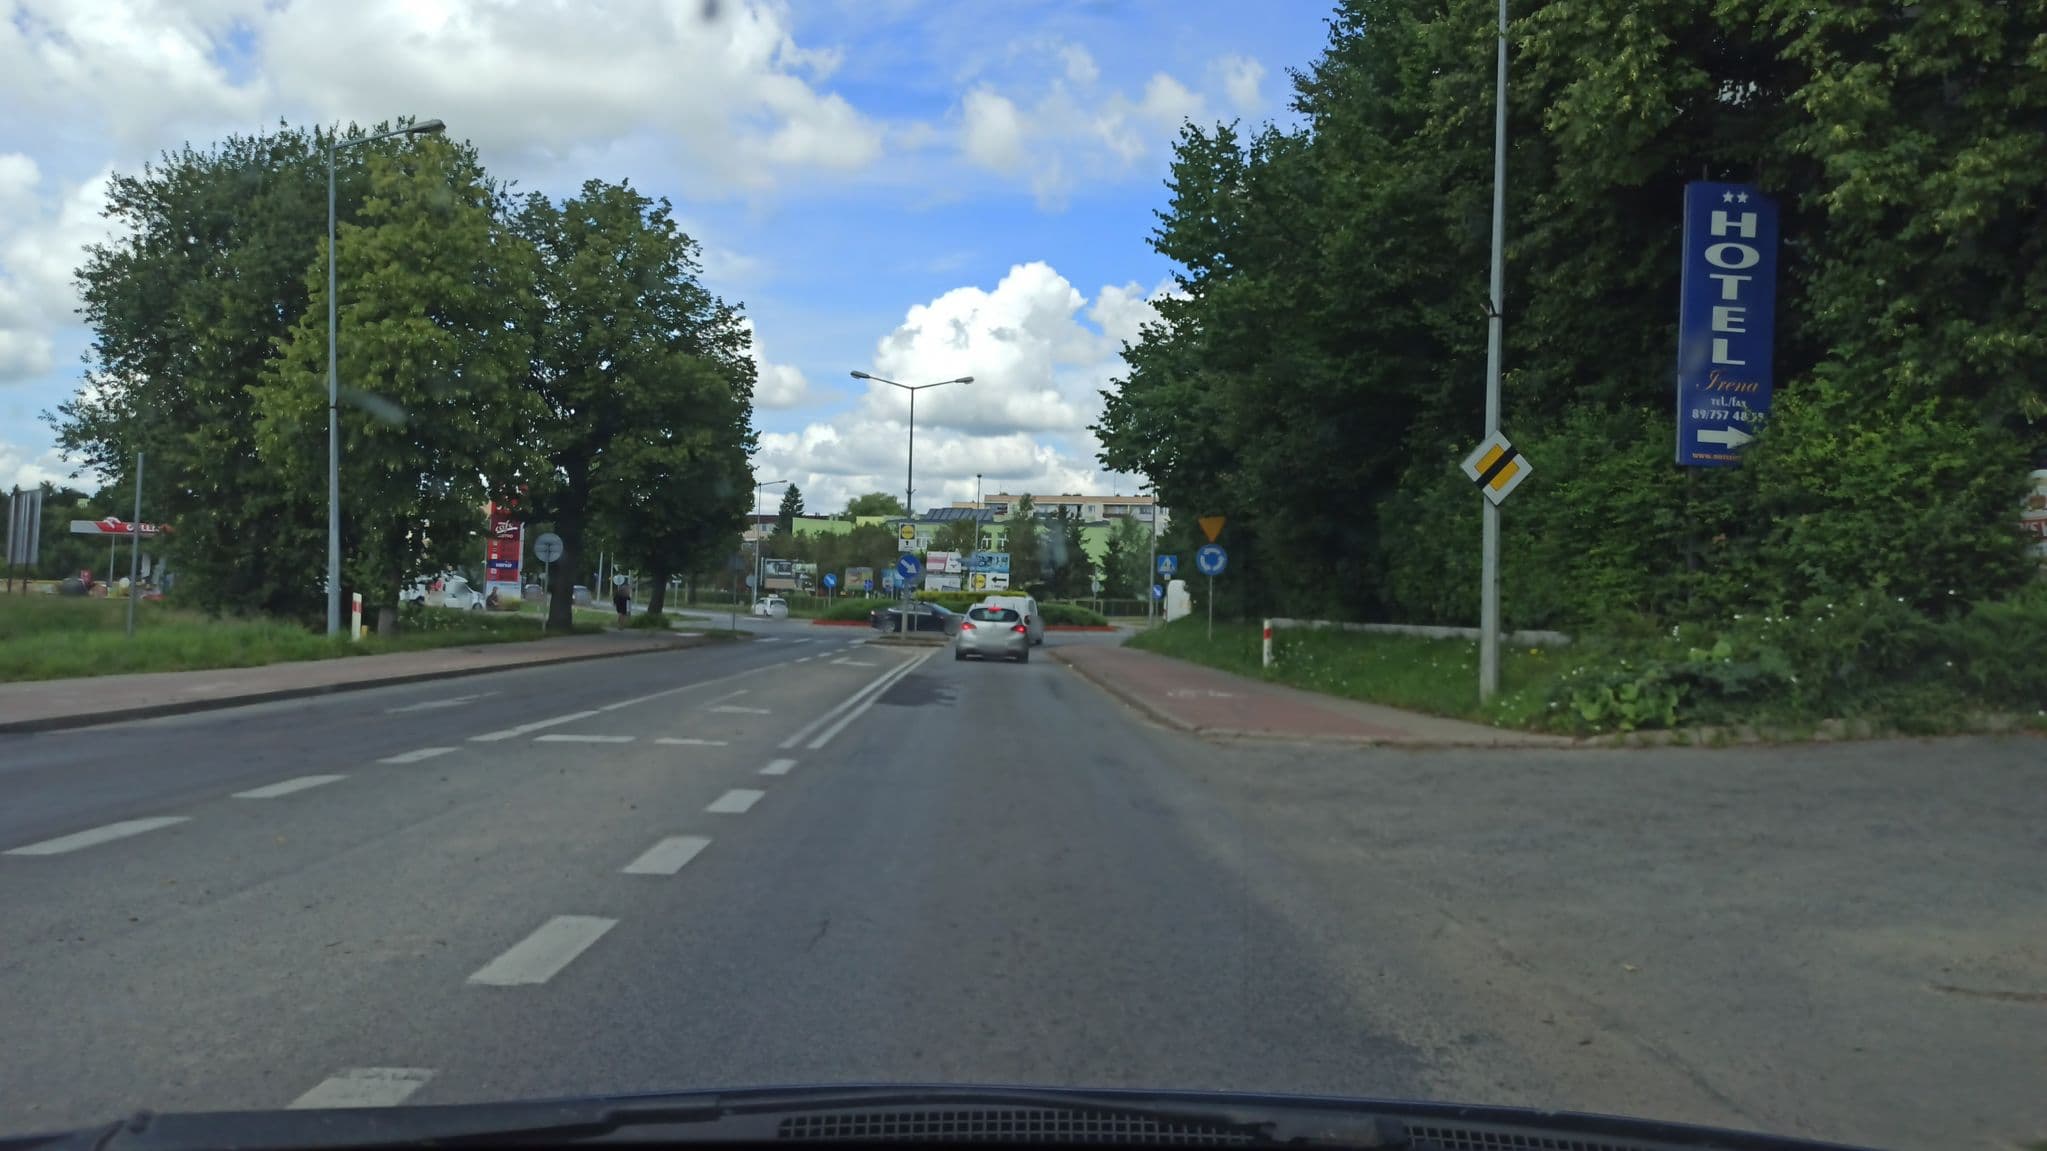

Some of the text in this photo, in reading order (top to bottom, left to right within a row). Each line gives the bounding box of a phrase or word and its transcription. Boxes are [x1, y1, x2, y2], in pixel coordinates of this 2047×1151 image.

[1704, 210, 1760, 366] HOTEL
[1699, 369, 1759, 392] Irena
[1692, 409, 1729, 420] 89/757
[1732, 411, 1748, 421] 48
